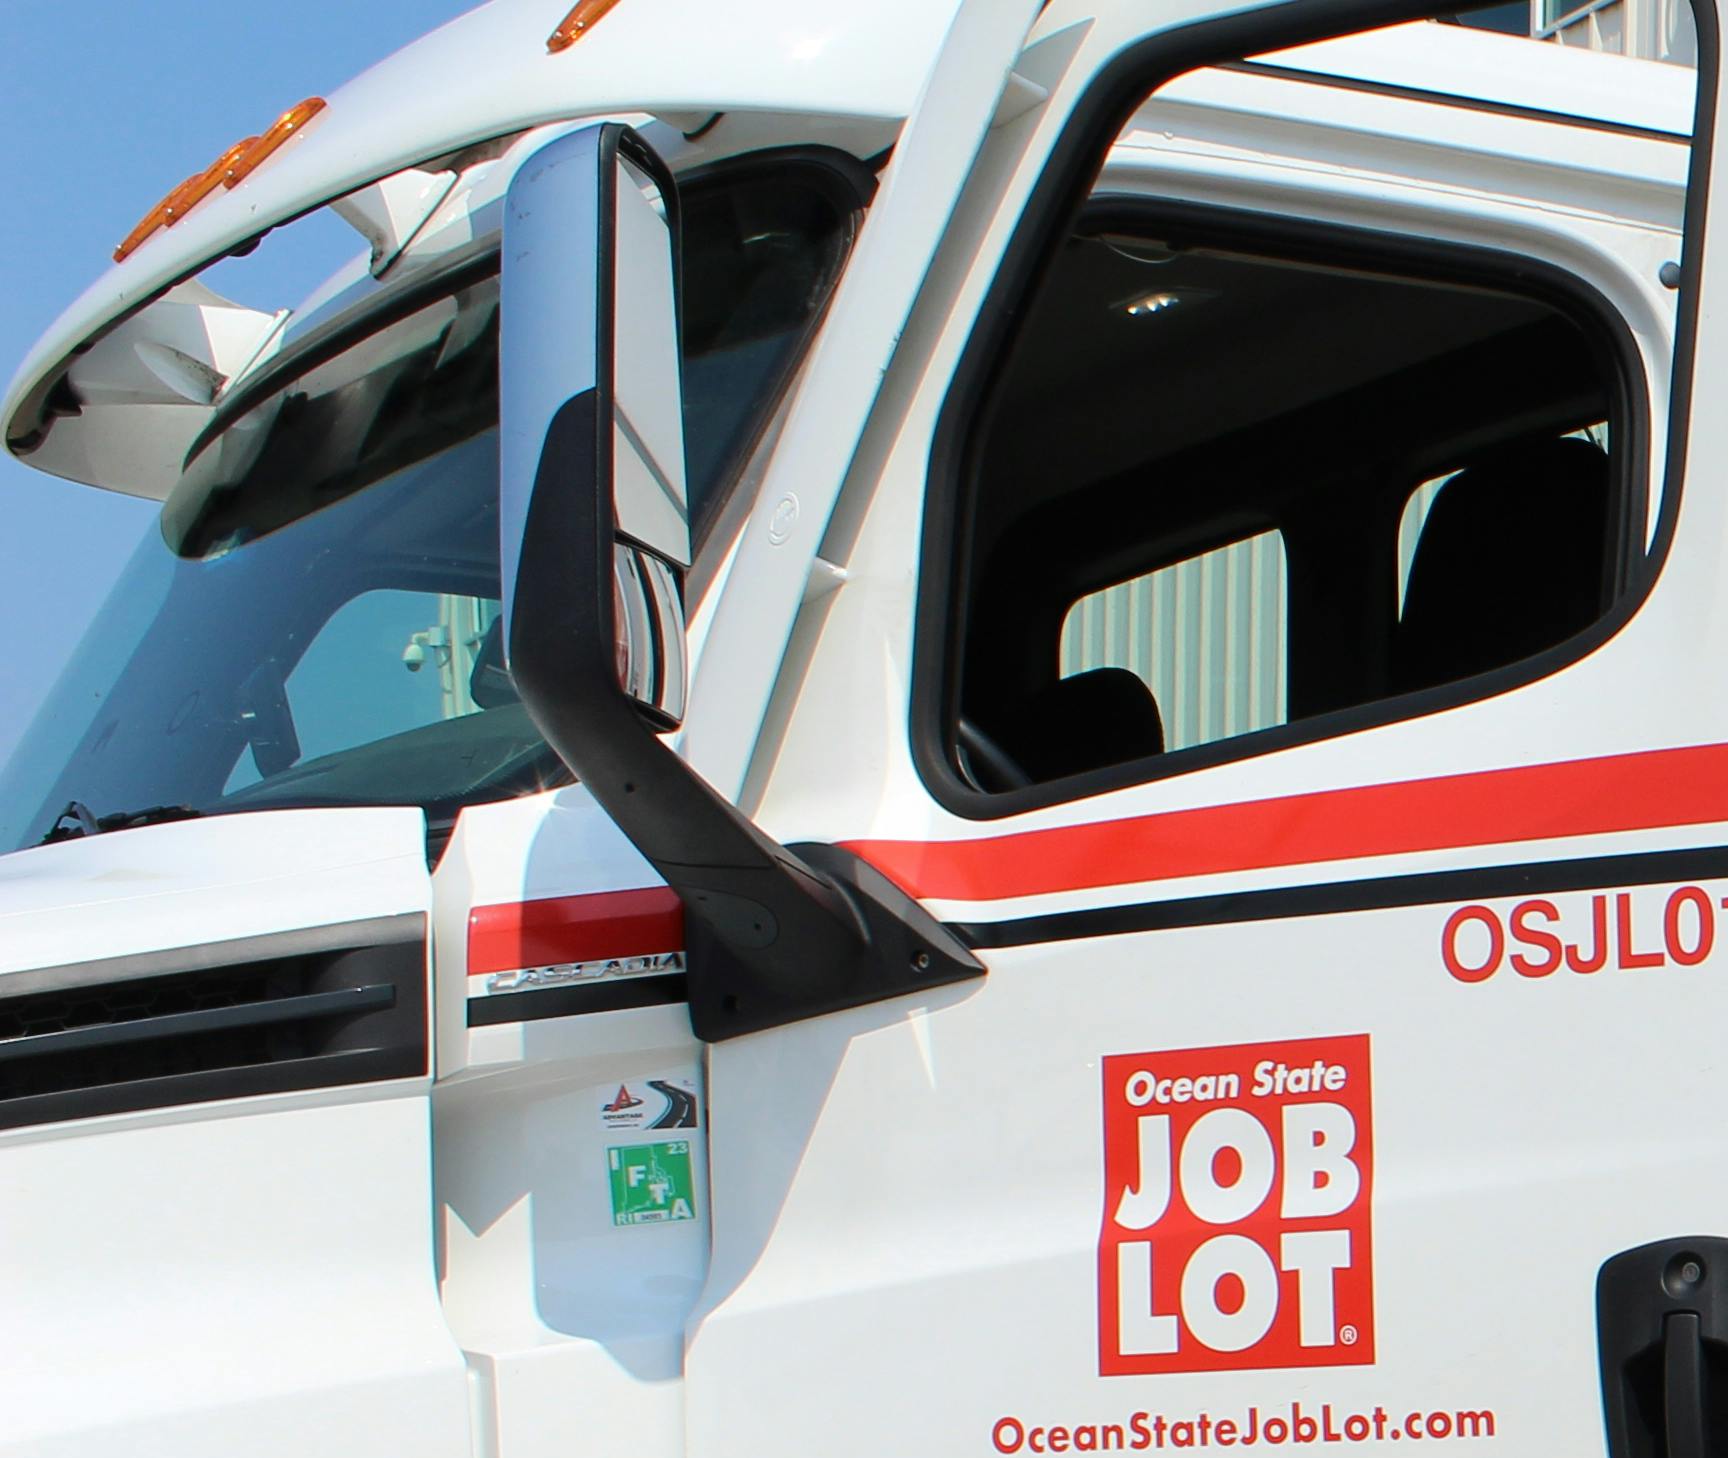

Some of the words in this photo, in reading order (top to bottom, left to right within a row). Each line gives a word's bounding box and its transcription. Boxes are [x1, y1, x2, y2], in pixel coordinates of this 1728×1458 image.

[487, 952, 685, 994] CASCADIA
[1125, 1071, 1239, 1106] Ocean
[1252, 1061, 1346, 1096] State
[667, 1142, 688, 1155] 23
[1114, 1102, 1361, 1231] JOB
[616, 1213, 633, 1226] RI
[992, 1402, 1496, 1455] OceanStateJobLot.com
